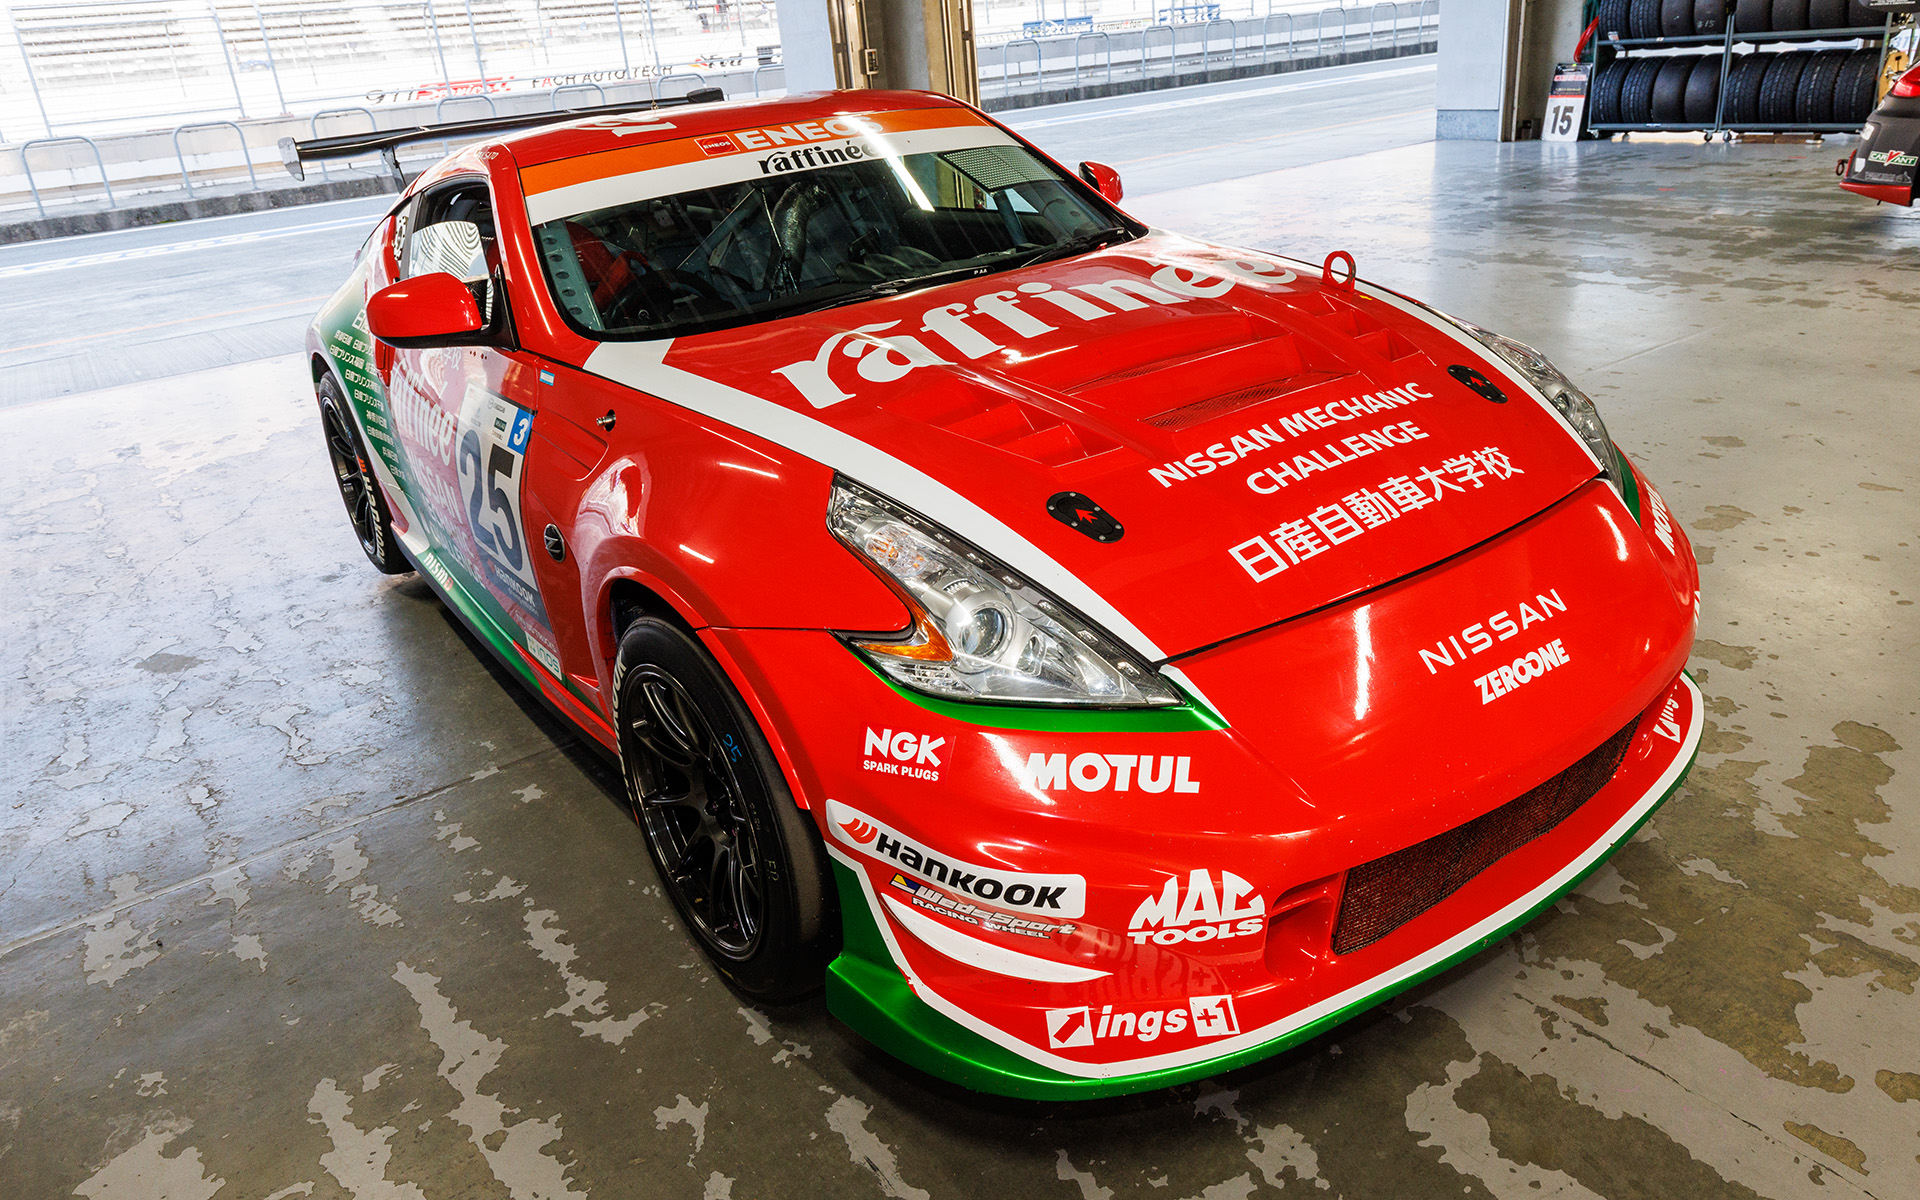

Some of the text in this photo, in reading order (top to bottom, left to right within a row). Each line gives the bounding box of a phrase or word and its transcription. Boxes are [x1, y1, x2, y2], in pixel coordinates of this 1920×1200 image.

[1551, 105, 1574, 135] 15
[703, 141, 731, 149] ENEOS
[1871, 149, 1914, 164] CARVANT
[513, 418, 529, 447] 3
[1147, 382, 1434, 489] NISSAN MECHANIC
[1246, 420, 1430, 495] CHALLENGE
[460, 430, 523, 571] 25
[1228, 446, 1524, 584] 日産自動車大学校
[1418, 588, 1567, 675] NISSAN
[1473, 638, 1570, 705] ZEROONE
[722, 733, 743, 762] 25
[863, 726, 946, 768] NGK
[863, 759, 940, 782] SPARK PLUGS
[1020, 752, 1200, 794] MOTUL
[912, 896, 1051, 939] RACING WHEEL
[915, 886, 1077, 935] WedsSport
[1128, 868, 1265, 930] MAC
[1127, 918, 1264, 945] TOOLS
[1096, 1005, 1188, 1042] ings
